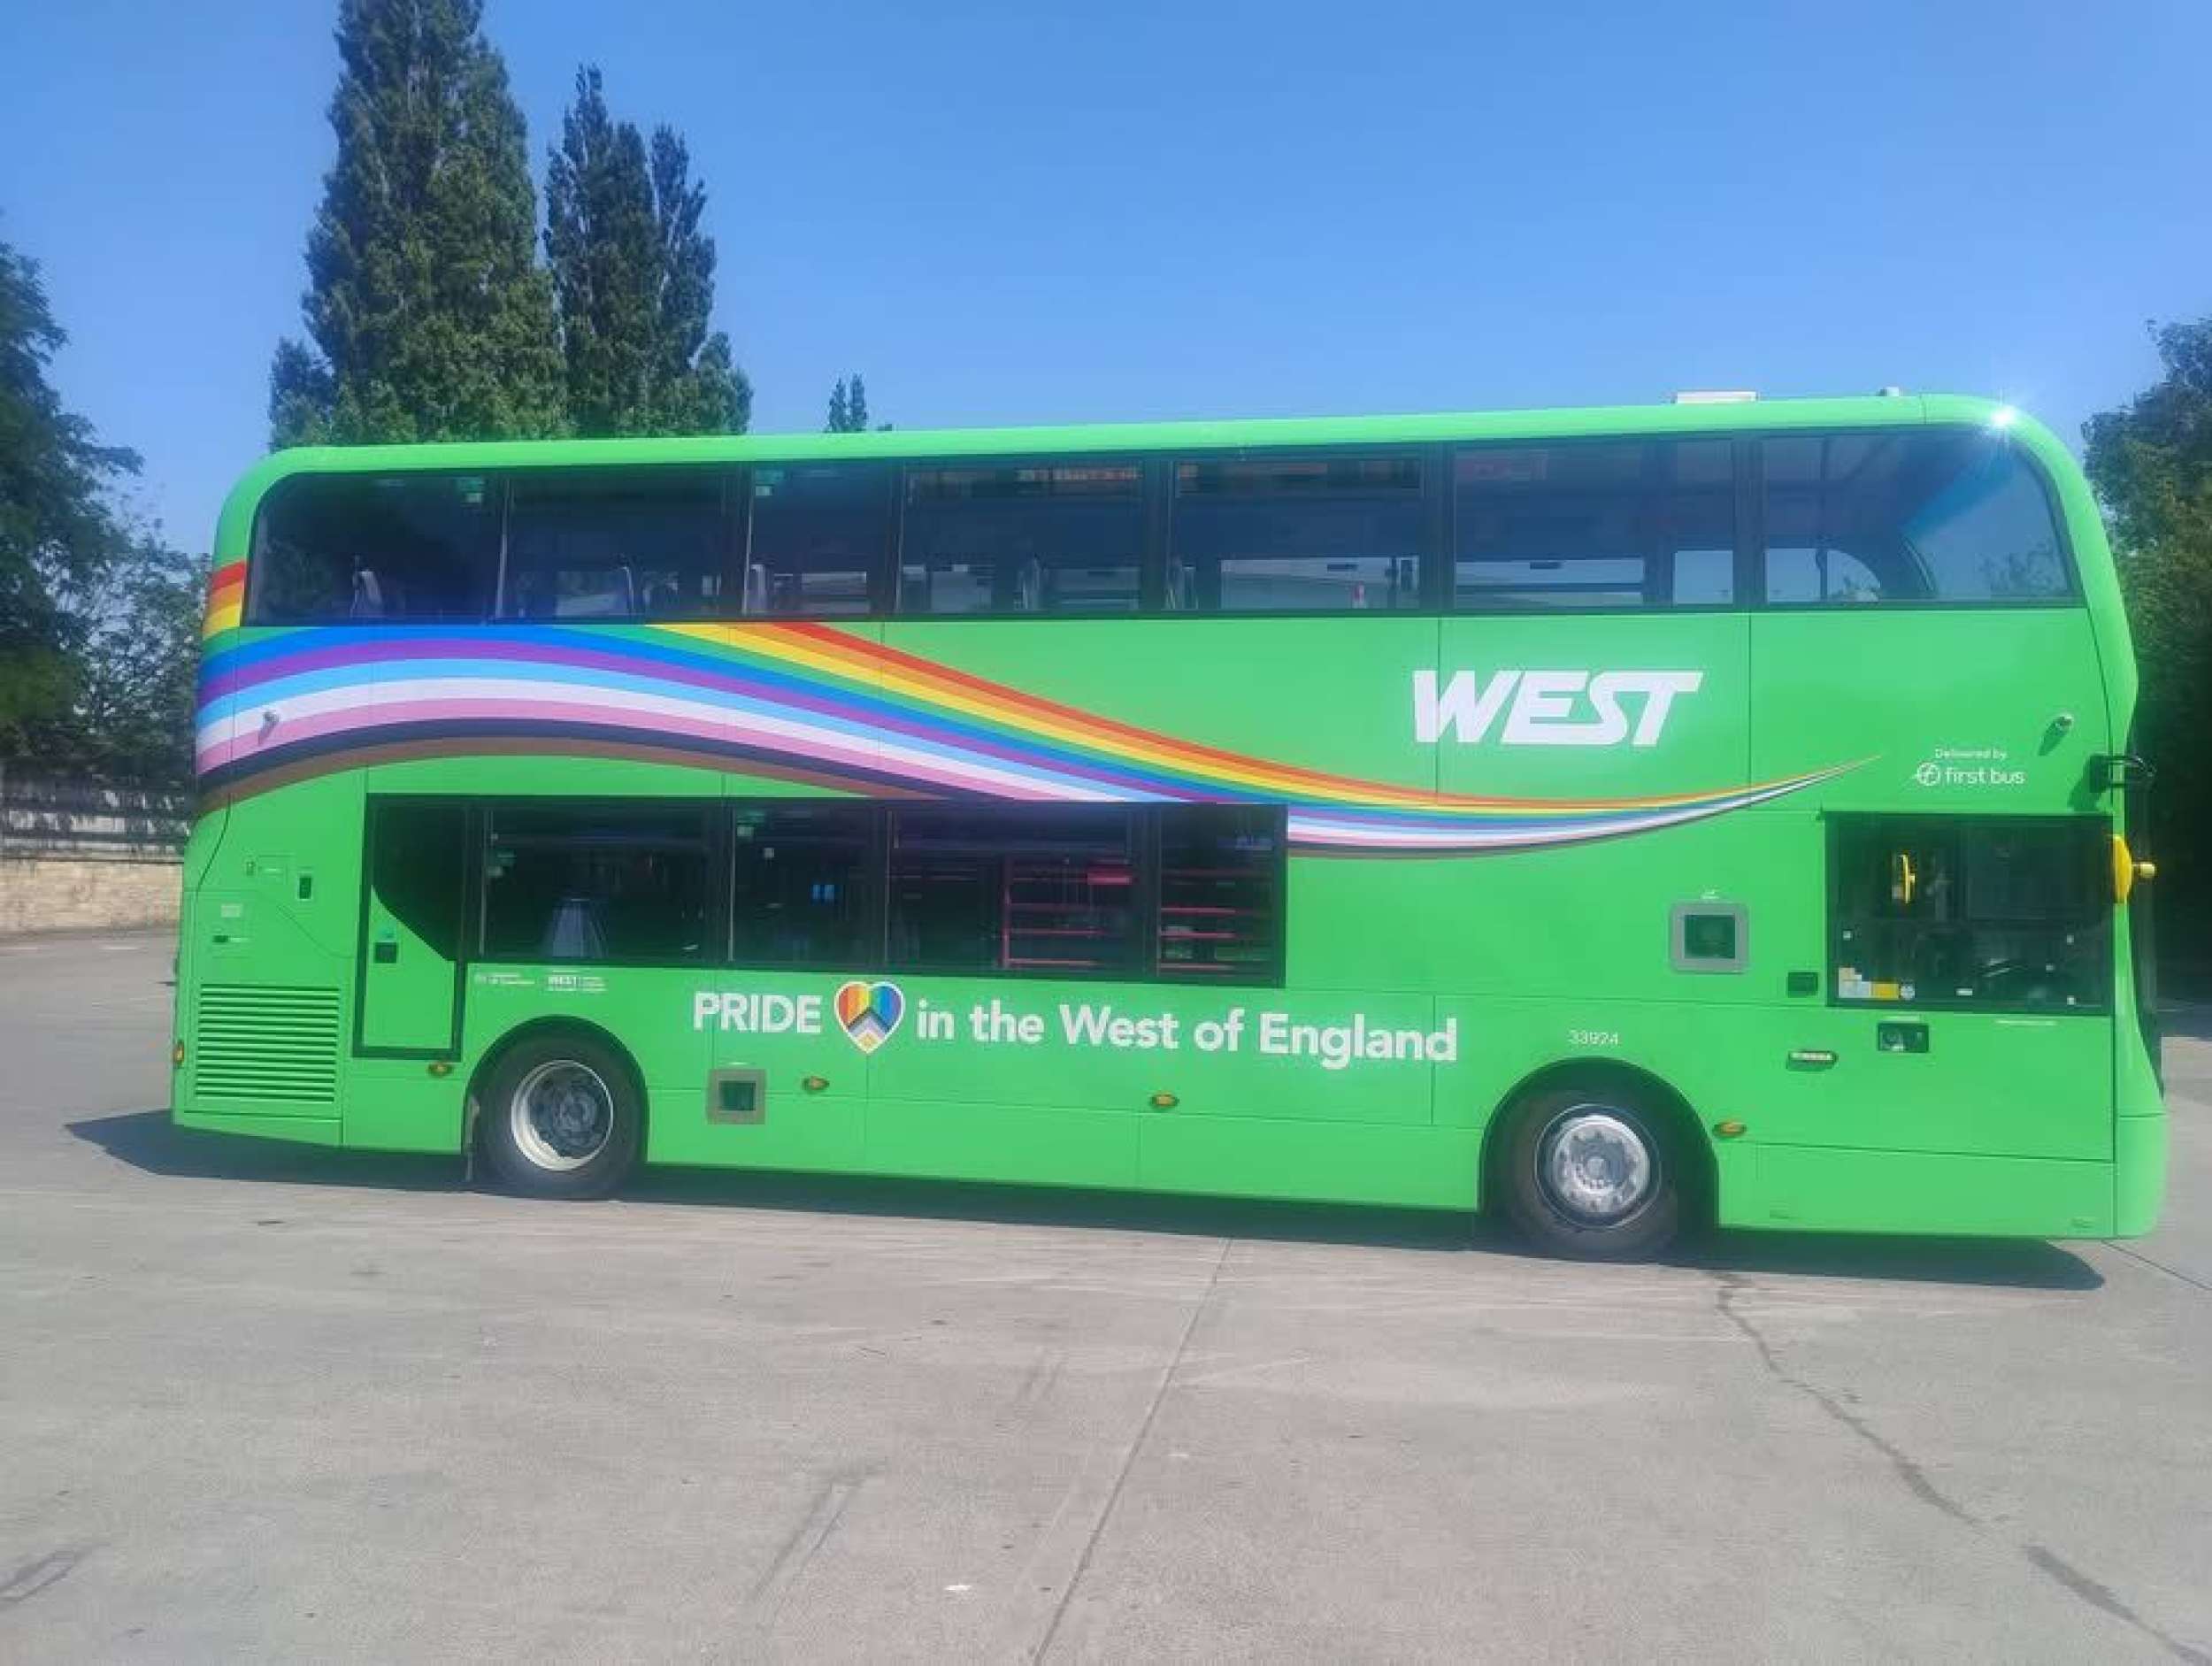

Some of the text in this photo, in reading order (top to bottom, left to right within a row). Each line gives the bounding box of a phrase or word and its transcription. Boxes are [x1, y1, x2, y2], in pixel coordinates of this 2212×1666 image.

[1412, 670, 1703, 746] WEST
[1946, 768, 2025, 785] first bus
[693, 991, 1458, 1070] PRIDE in the West of England
